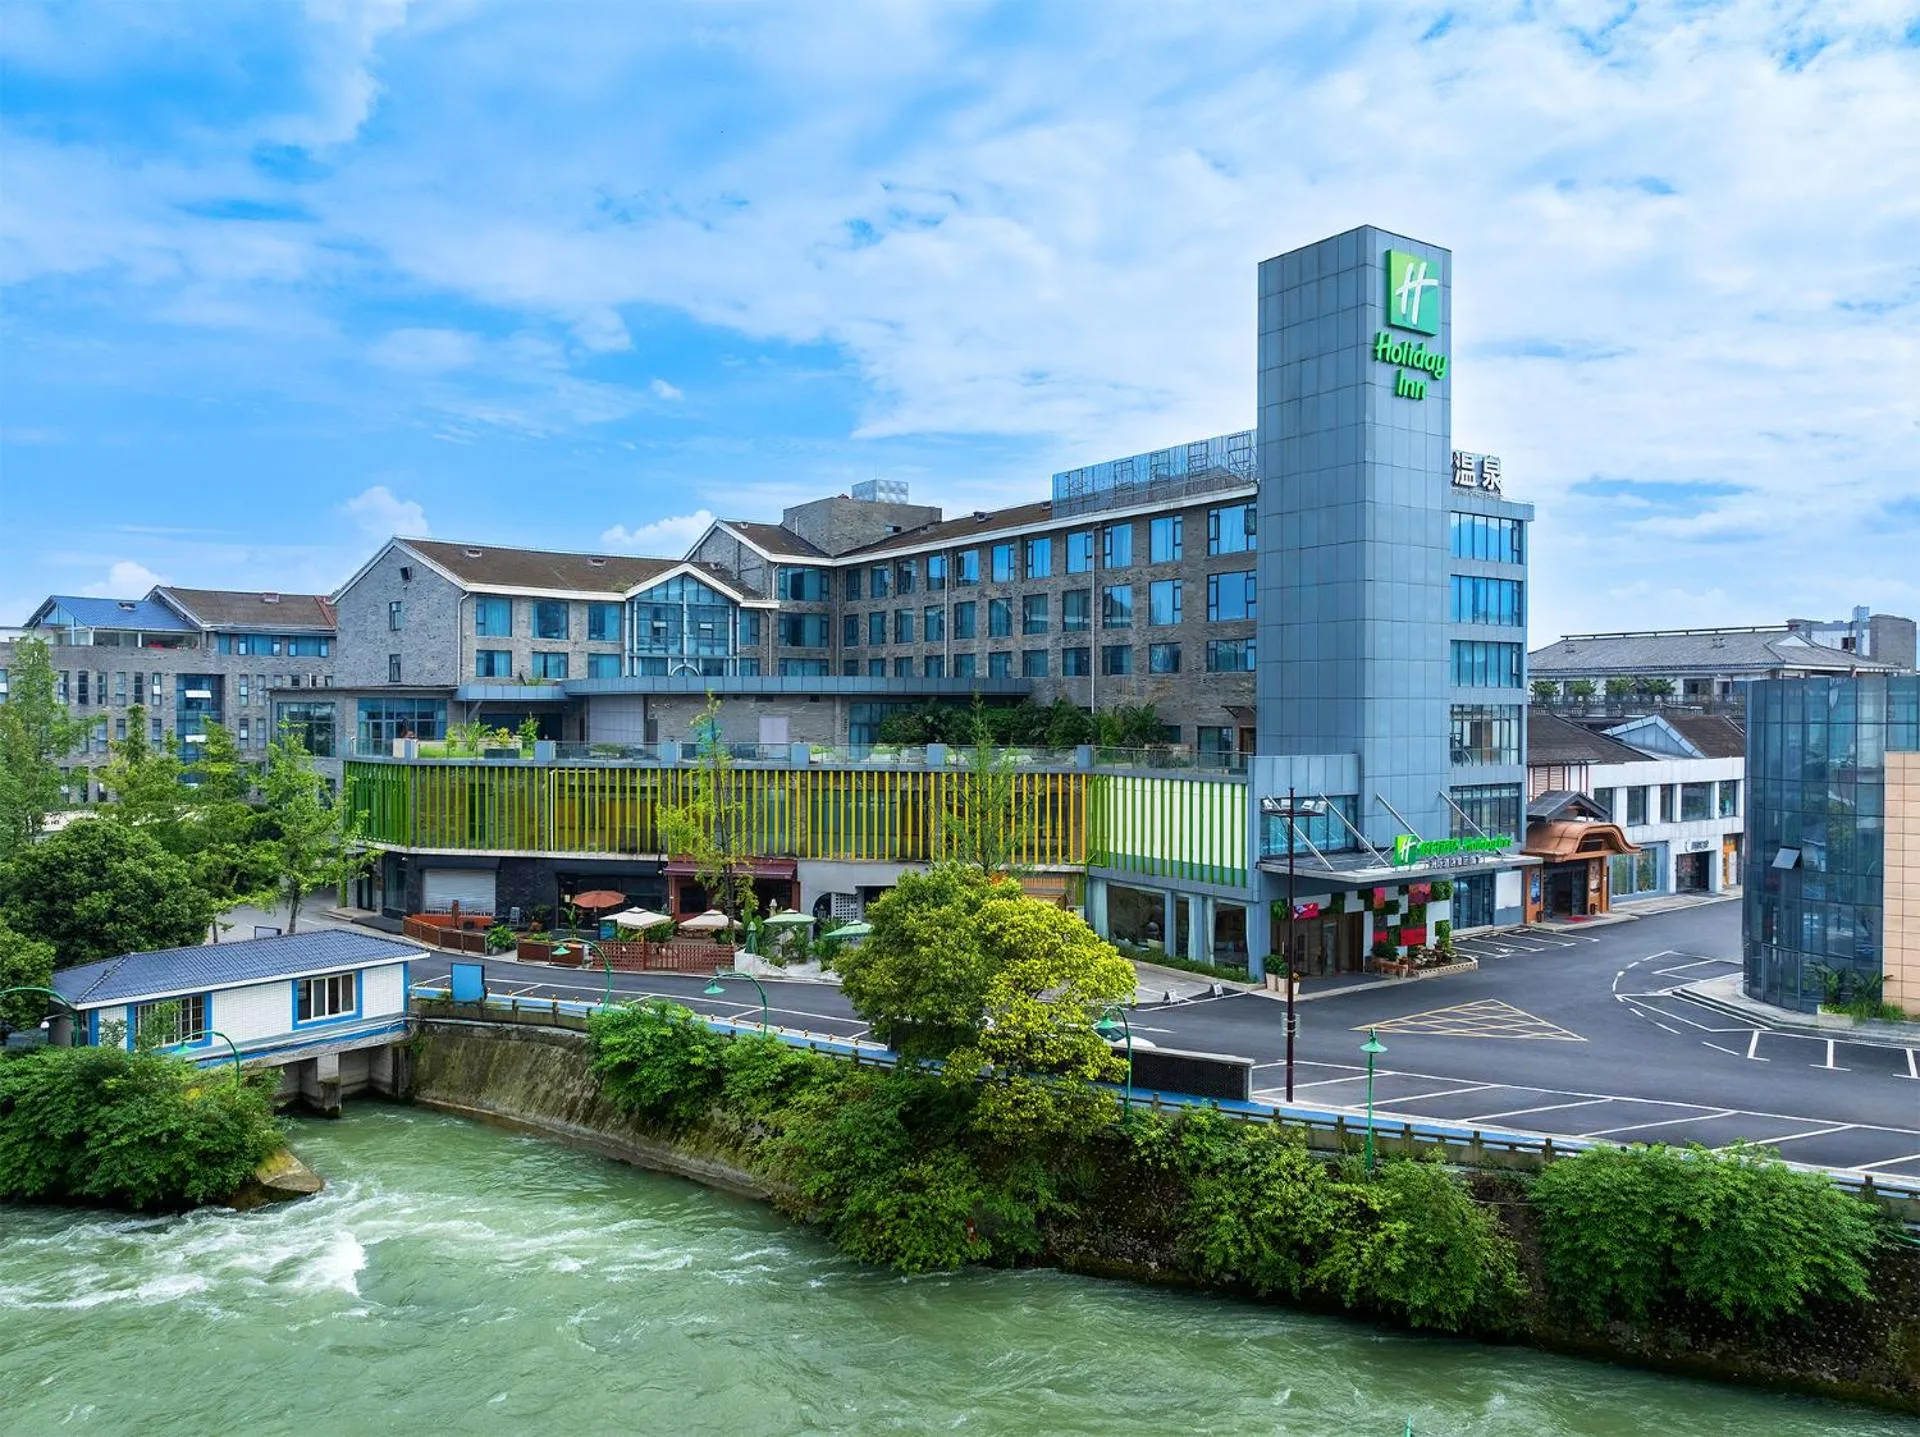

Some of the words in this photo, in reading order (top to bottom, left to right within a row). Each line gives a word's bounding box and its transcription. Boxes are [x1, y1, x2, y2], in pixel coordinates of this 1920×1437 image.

[1374, 331, 1447, 380] Holiday
[1396, 368, 1427, 400] Inn
[1452, 451, 1501, 492] 温泉
